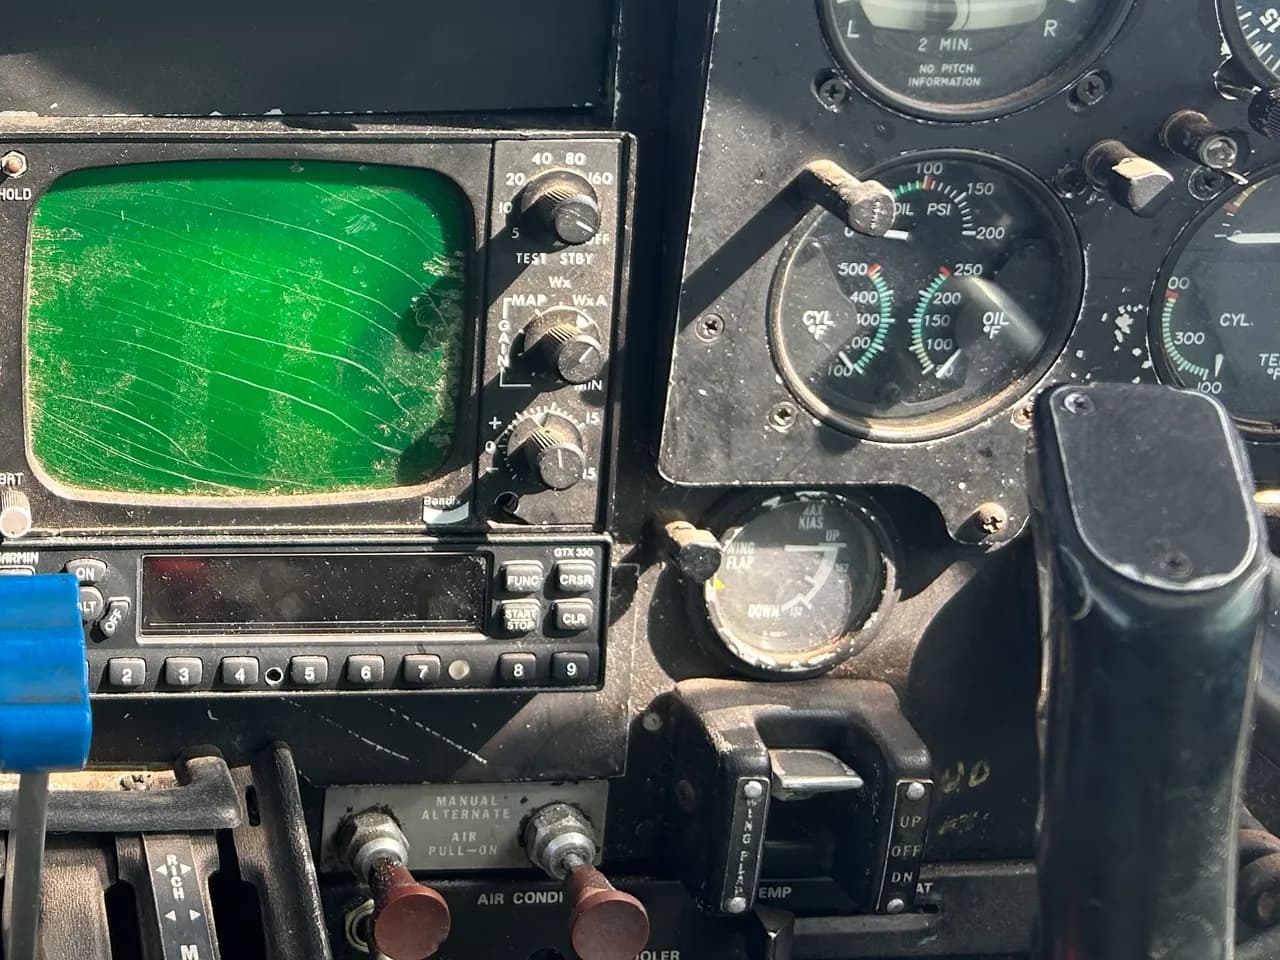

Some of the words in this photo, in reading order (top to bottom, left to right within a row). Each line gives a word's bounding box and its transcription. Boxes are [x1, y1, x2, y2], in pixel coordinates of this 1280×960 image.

[847, 21, 859, 38] L
[1043, 20, 1058, 37] R
[919, 63, 935, 74] NO
[941, 63, 975, 74] PITCH
[908, 77, 981, 88] INFORMATION
[532, 153, 553, 165] 40
[505, 173, 526, 185] 20
[976, 228, 1005, 239] 200
[516, 253, 546, 264] TEST
[560, 253, 595, 265] STBY
[802, 311, 834, 325] CYL
[982, 312, 1009, 325] OIL
[554, 548, 574, 557] GTX
[576, 548, 593, 557] 330
[76, 568, 95, 580] ON
[508, 575, 538, 585] FUNC
[560, 575, 592, 586] CRSR
[105, 609, 123, 631] OFF
[505, 610, 536, 619] START
[563, 614, 585, 624] CLR
[507, 621, 534, 630] STOP
[122, 668, 132, 681] 2
[179, 668, 189, 681] 3
[235, 667, 245, 680] 4
[304, 667, 315, 680] 5
[360, 666, 371, 679] 6
[418, 665, 428, 679] 7
[514, 665, 523, 677] 8
[567, 663, 576, 676] 9
[435, 796, 498, 807] MANUAL
[421, 808, 511, 821] ALTERNATE
[900, 817, 920, 827] UP
[451, 831, 477, 842] AIR
[891, 846, 920, 856] OFF
[166, 854, 185, 899] RICH
[891, 872, 913, 882] DN
[477, 893, 504, 905] AIR
